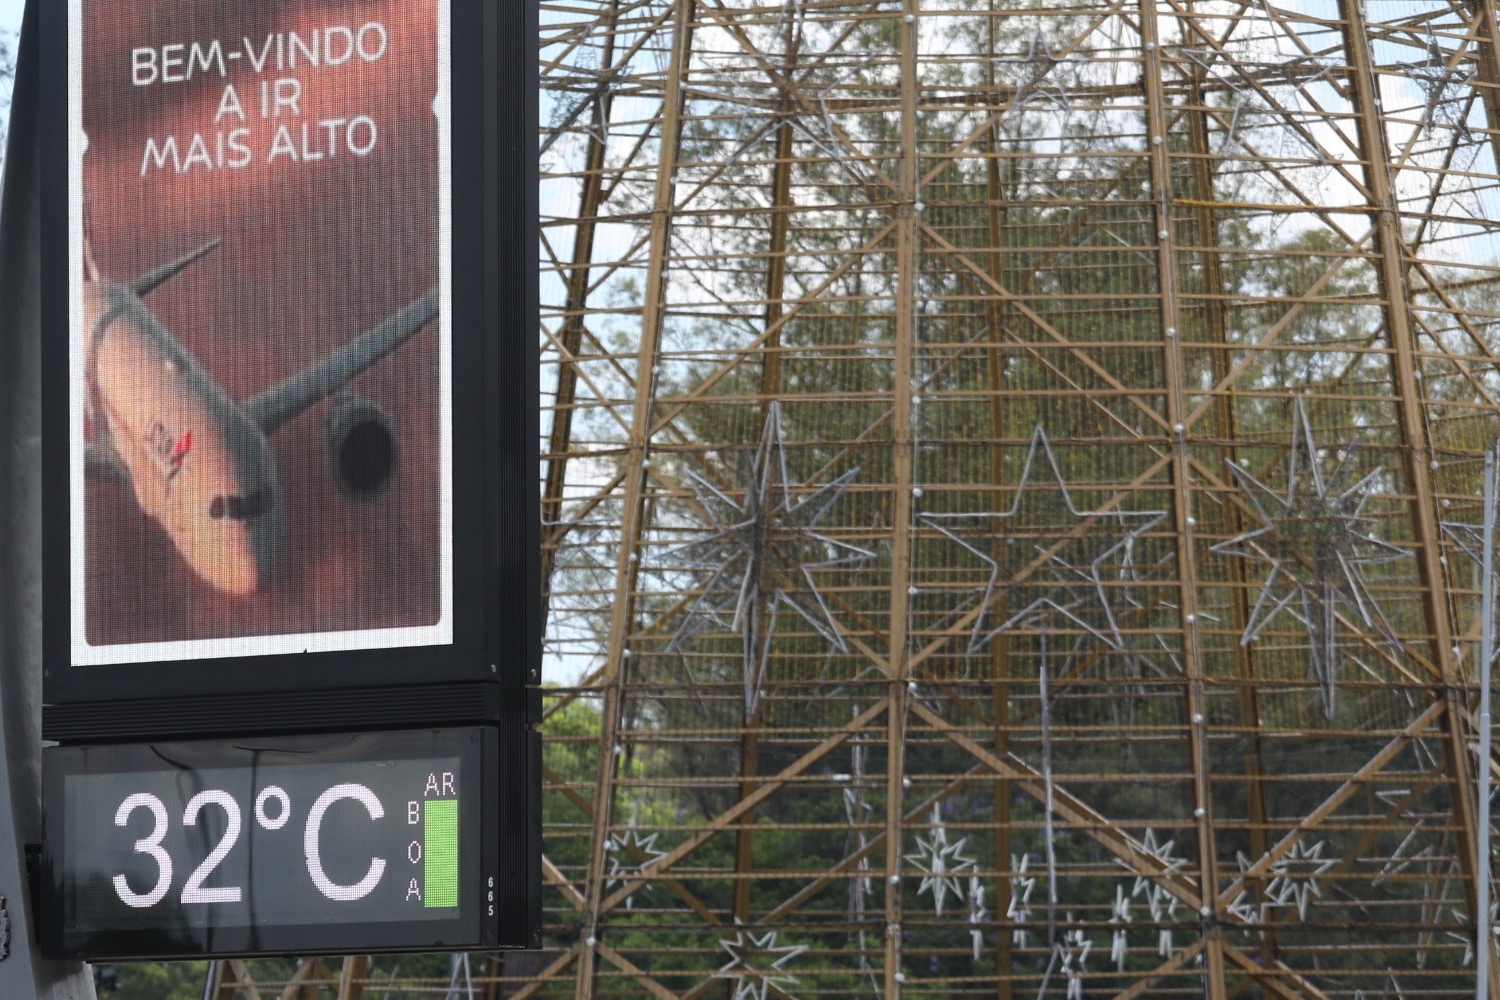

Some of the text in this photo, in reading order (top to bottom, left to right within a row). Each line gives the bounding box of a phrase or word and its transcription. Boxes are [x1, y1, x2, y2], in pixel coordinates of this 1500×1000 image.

[131, 22, 388, 86] BEM-VINDO
[215, 78, 301, 123] A IR
[140, 115, 377, 178] MAIS ALTO
[424, 772, 456, 796] AR
[112, 782, 387, 908] 32°C
